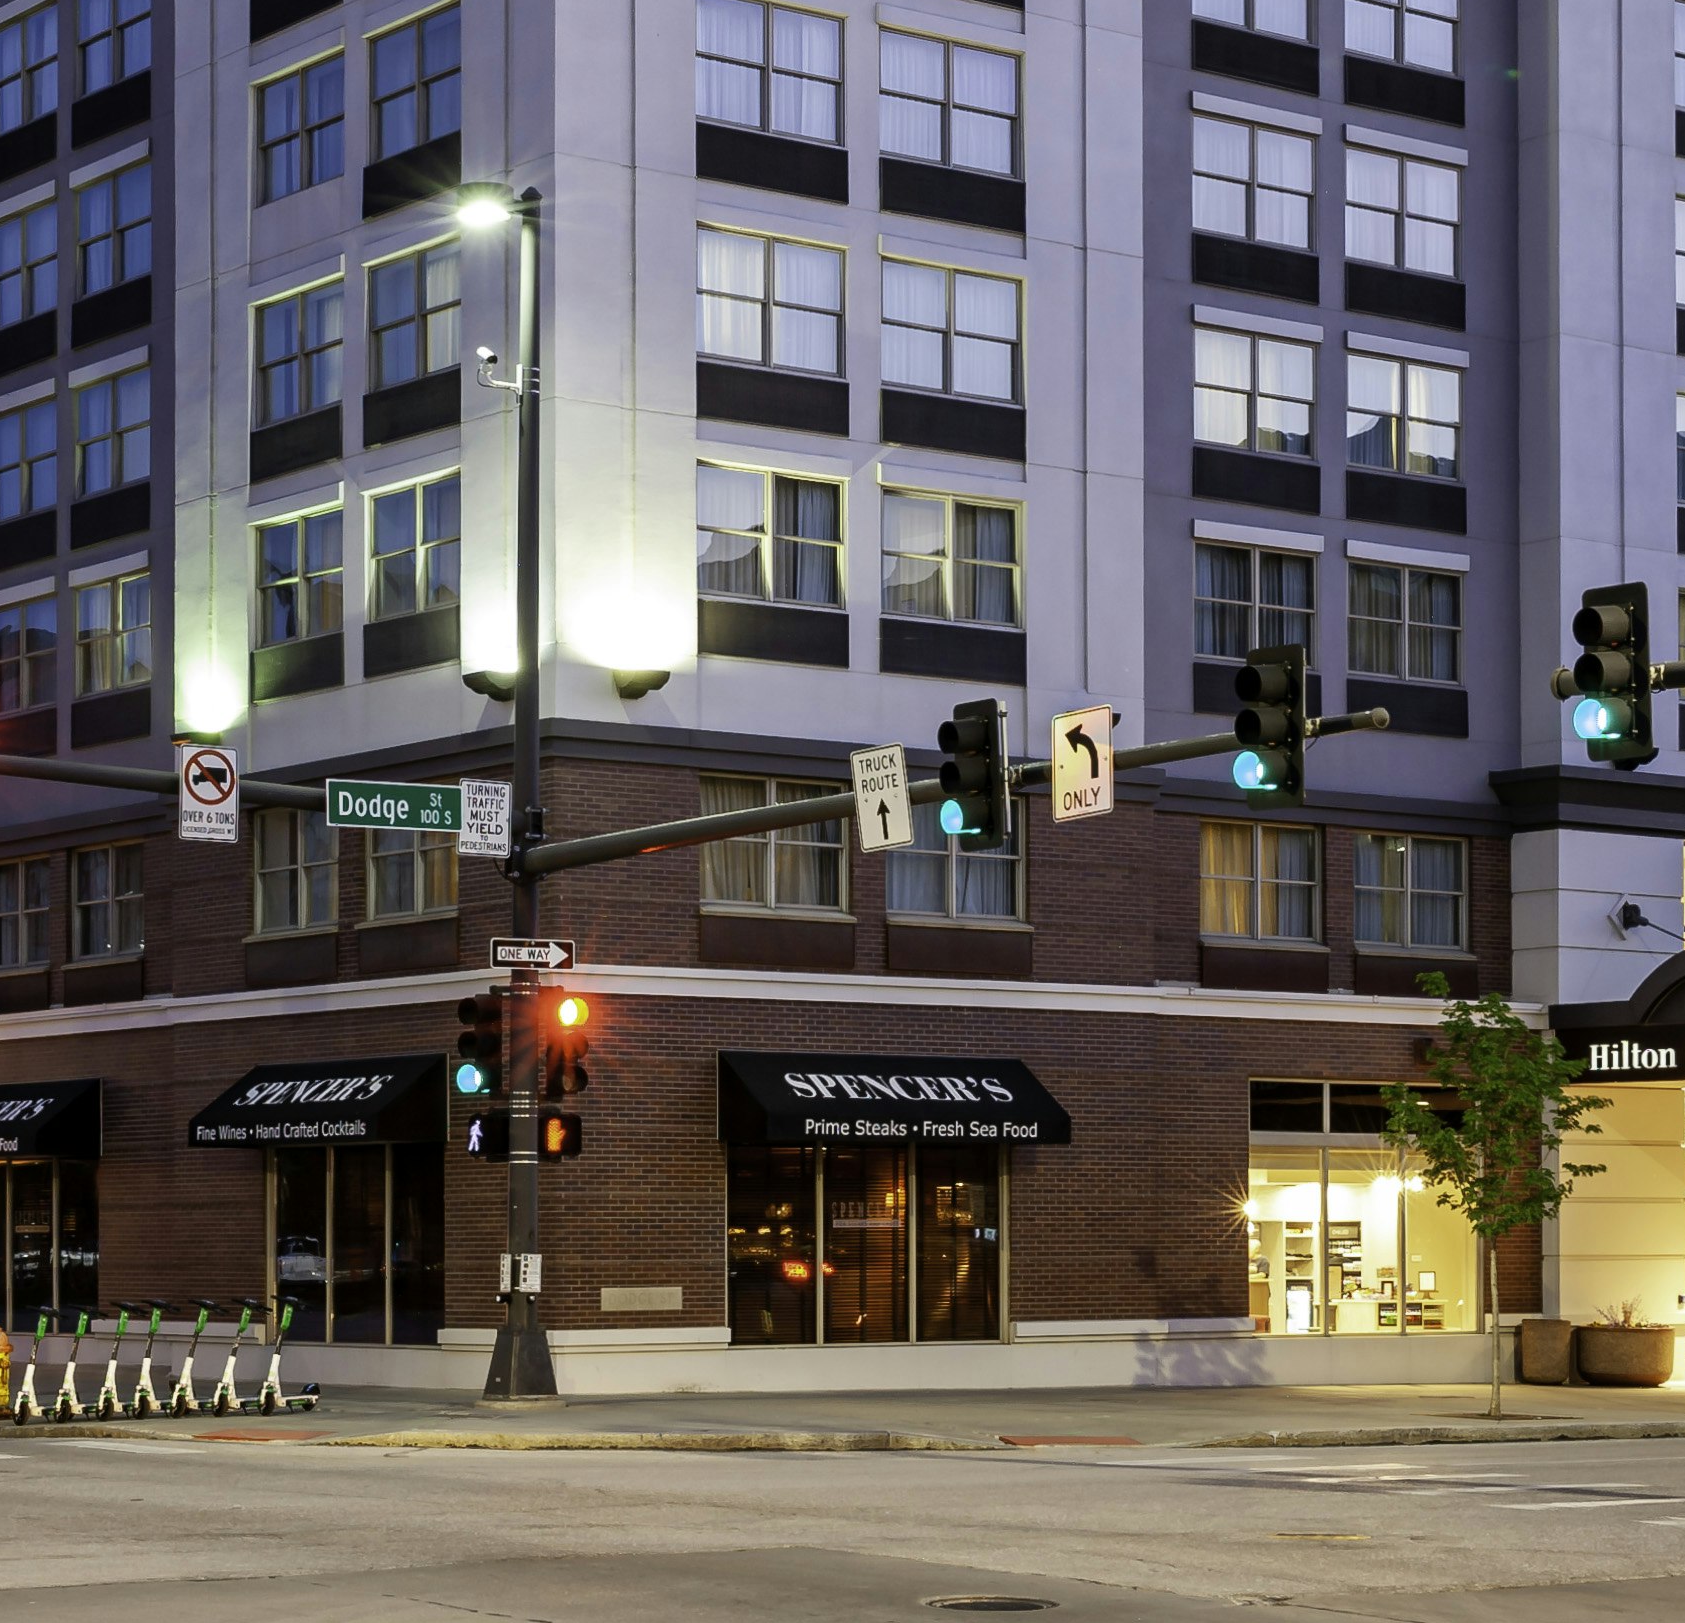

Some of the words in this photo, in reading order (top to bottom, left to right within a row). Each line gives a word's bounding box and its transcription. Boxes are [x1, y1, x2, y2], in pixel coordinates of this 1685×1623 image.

[858, 752, 897, 774] TRUCK
[466, 783, 506, 798] TURNING
[861, 773, 899, 794] ROUTE
[466, 796, 504, 810] TRAFFIC
[1063, 785, 1101, 811] ONLY
[338, 790, 409, 825] Dodge
[429, 792, 442, 809] St
[183, 810, 203, 823] OVER
[206, 812, 213, 823] 6
[215, 812, 234, 825] TONS
[420, 809, 439, 824] 100
[444, 811, 452, 825] S
[469, 810, 500, 823] MUST
[466, 822, 504, 836] YIELD
[460, 840, 507, 853] PEDESTRIANS
[500, 948, 522, 959] ONE
[527, 949, 551, 960] WAY
[1589, 1040, 1677, 1070] Hilton
[232, 1074, 395, 1106] SPENCER'S
[784, 1072, 1014, 1103] SPENCER'S
[196, 1126, 216, 1141] Fine
[218, 1124, 247, 1140] Wines
[255, 1123, 281, 1139] Hand
[283, 1122, 319, 1138] Crafted
[321, 1119, 366, 1137] Cocktails
[805, 1119, 850, 1136] Prime
[855, 1119, 907, 1136] Steaks
[923, 1120, 964, 1137] Fresh
[969, 1121, 998, 1137] Sea
[1003, 1122, 1038, 1138] Food
[0, 1137, 18, 1151] Food
